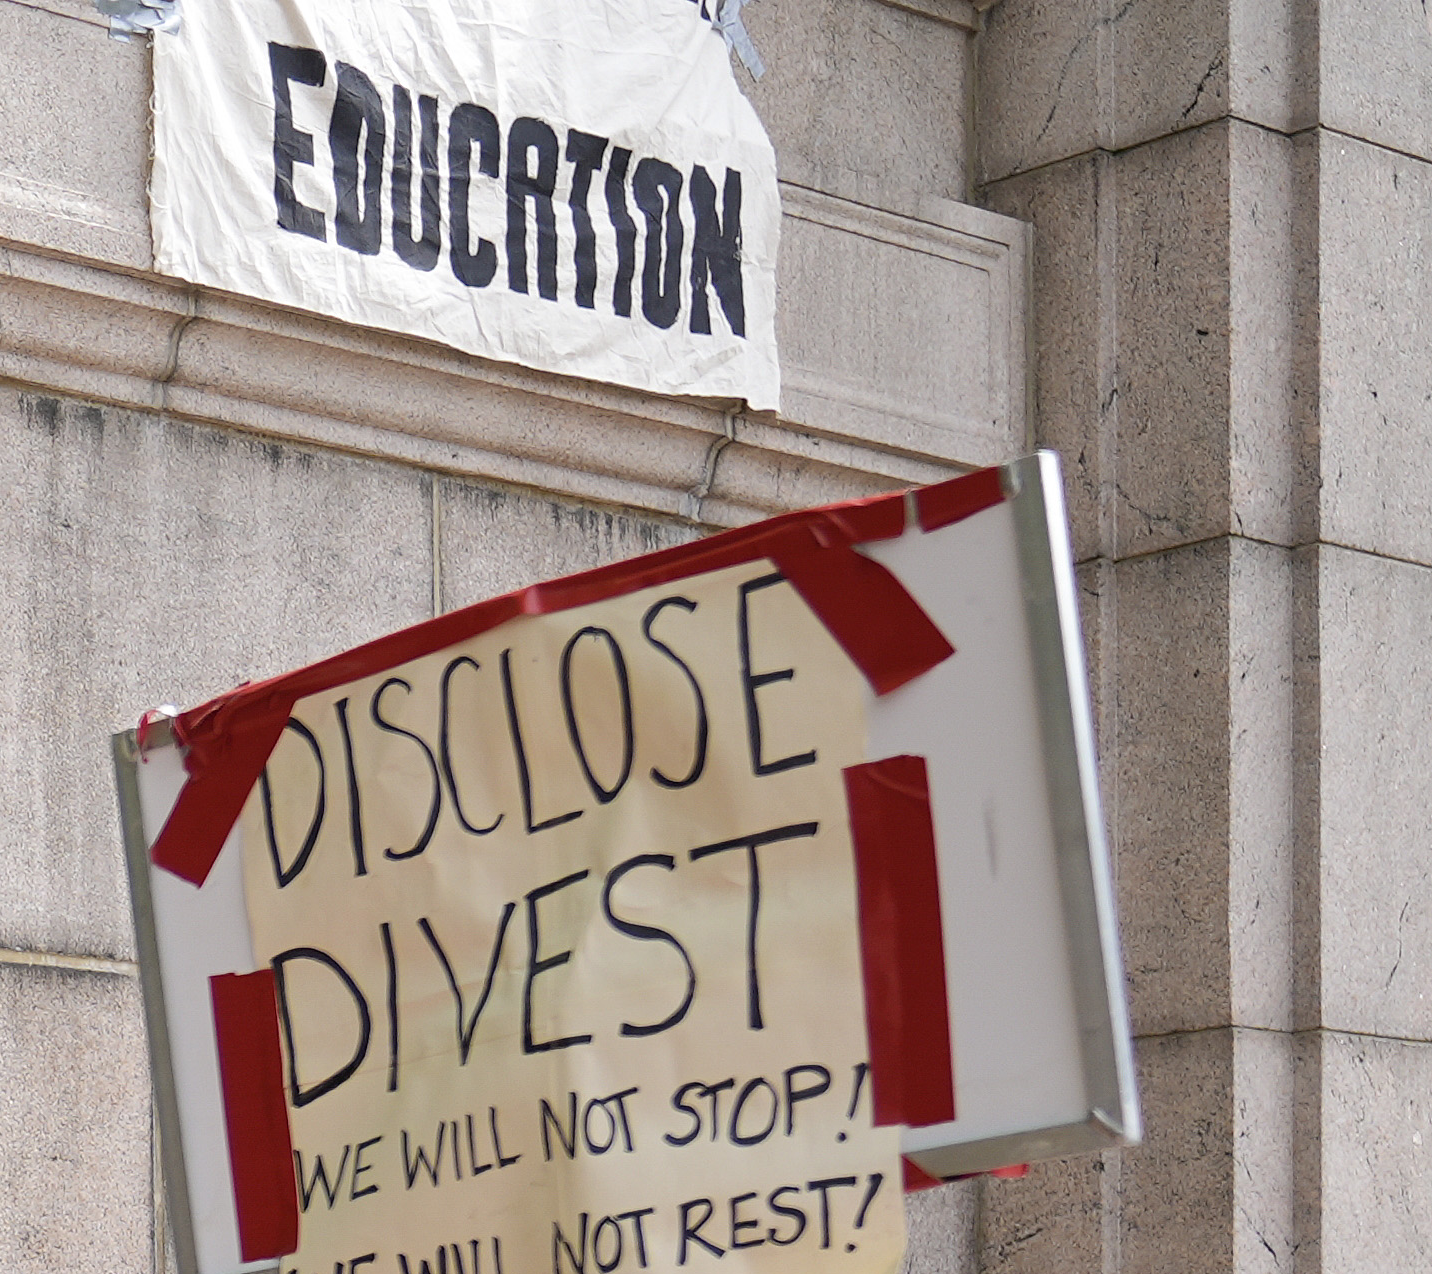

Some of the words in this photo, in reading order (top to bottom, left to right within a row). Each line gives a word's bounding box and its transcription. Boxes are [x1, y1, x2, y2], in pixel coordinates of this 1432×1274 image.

[267, 41, 746, 339] EDUCATION
[257, 572, 818, 890] DISCLOSE
[269, 821, 819, 1110] DIVEST
[294, 1135, 384, 1213] WE
[401, 1120, 519, 1189] WILL
[540, 1086, 639, 1165] NOT
[665, 1063, 869, 1149] STOP!
[678, 1173, 884, 1265] REST!
